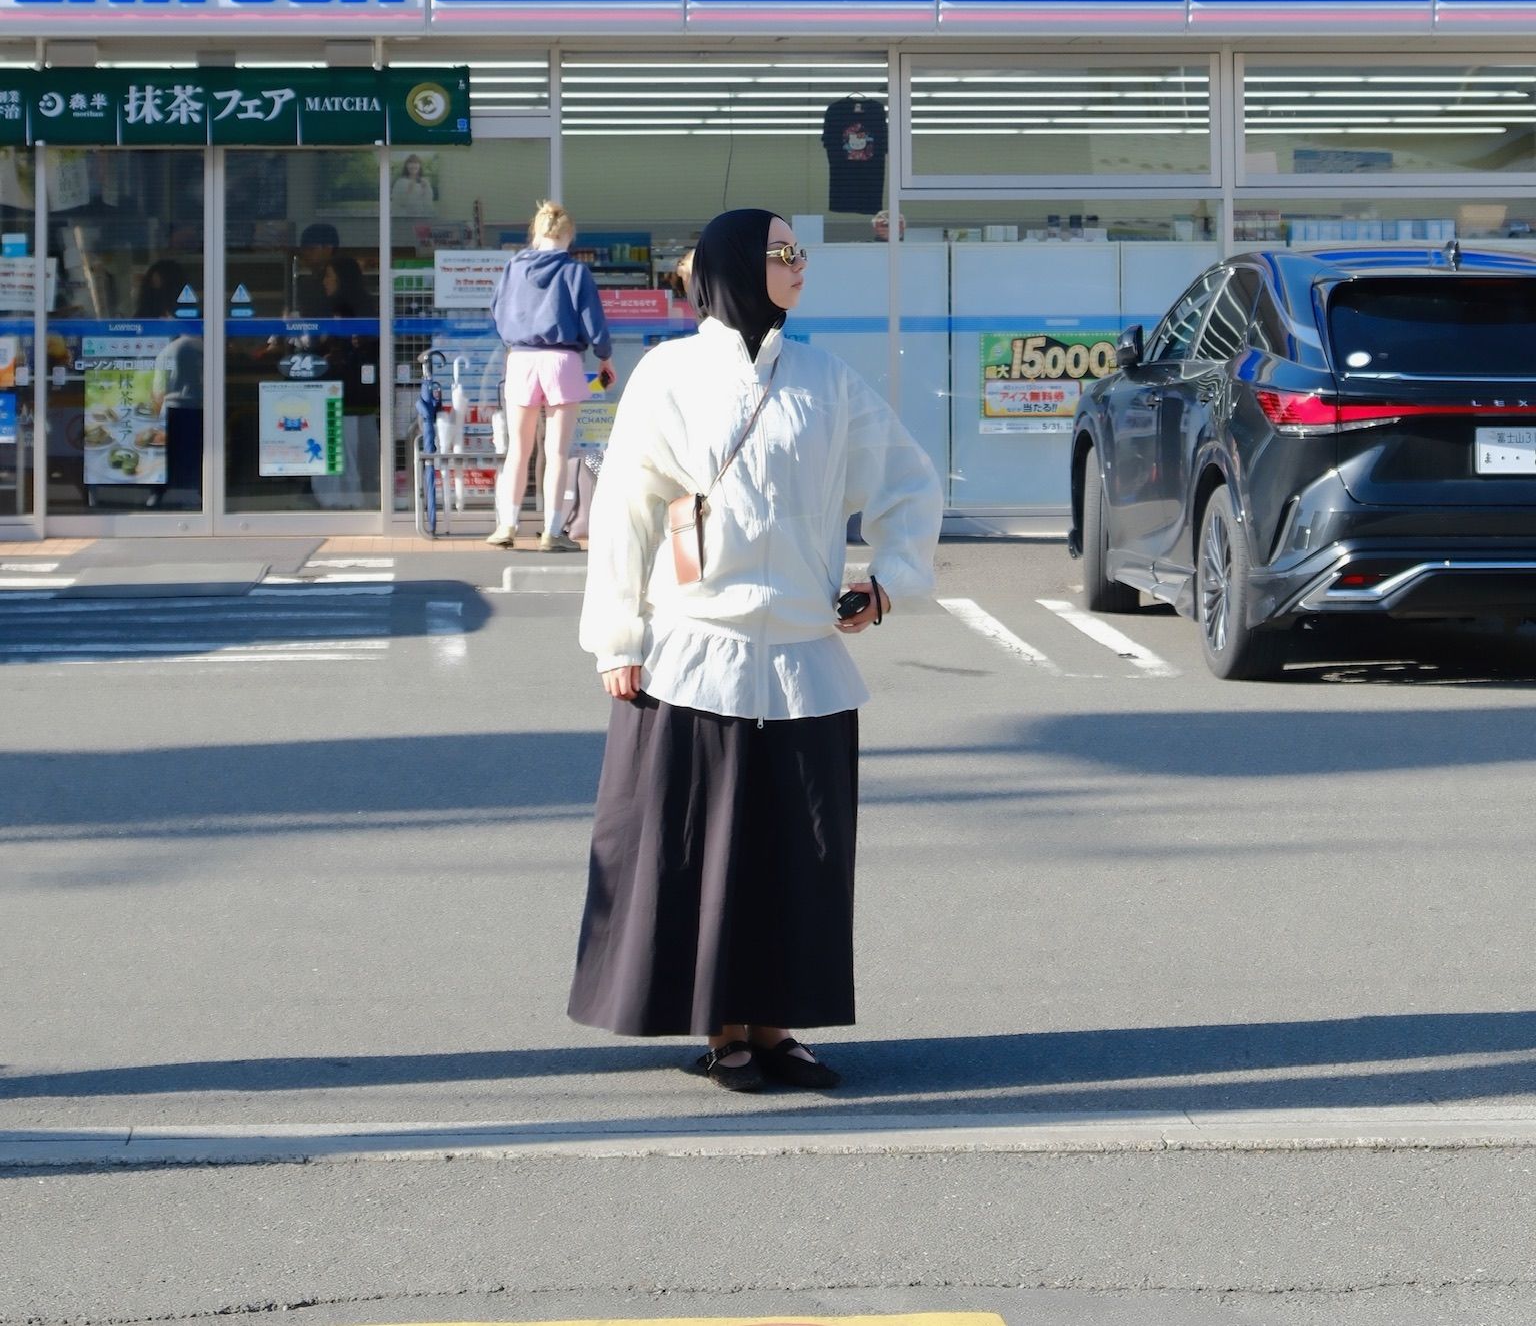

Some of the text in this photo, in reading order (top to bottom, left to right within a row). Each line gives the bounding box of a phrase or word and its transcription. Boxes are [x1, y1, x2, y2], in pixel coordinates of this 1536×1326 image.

[123, 85, 381, 124] 抹茶フェア MATCHA
[290, 355, 313, 371] 24
[576, 416, 614, 425] XCHANG
[1497, 432, 1536, 444] 富士山3
